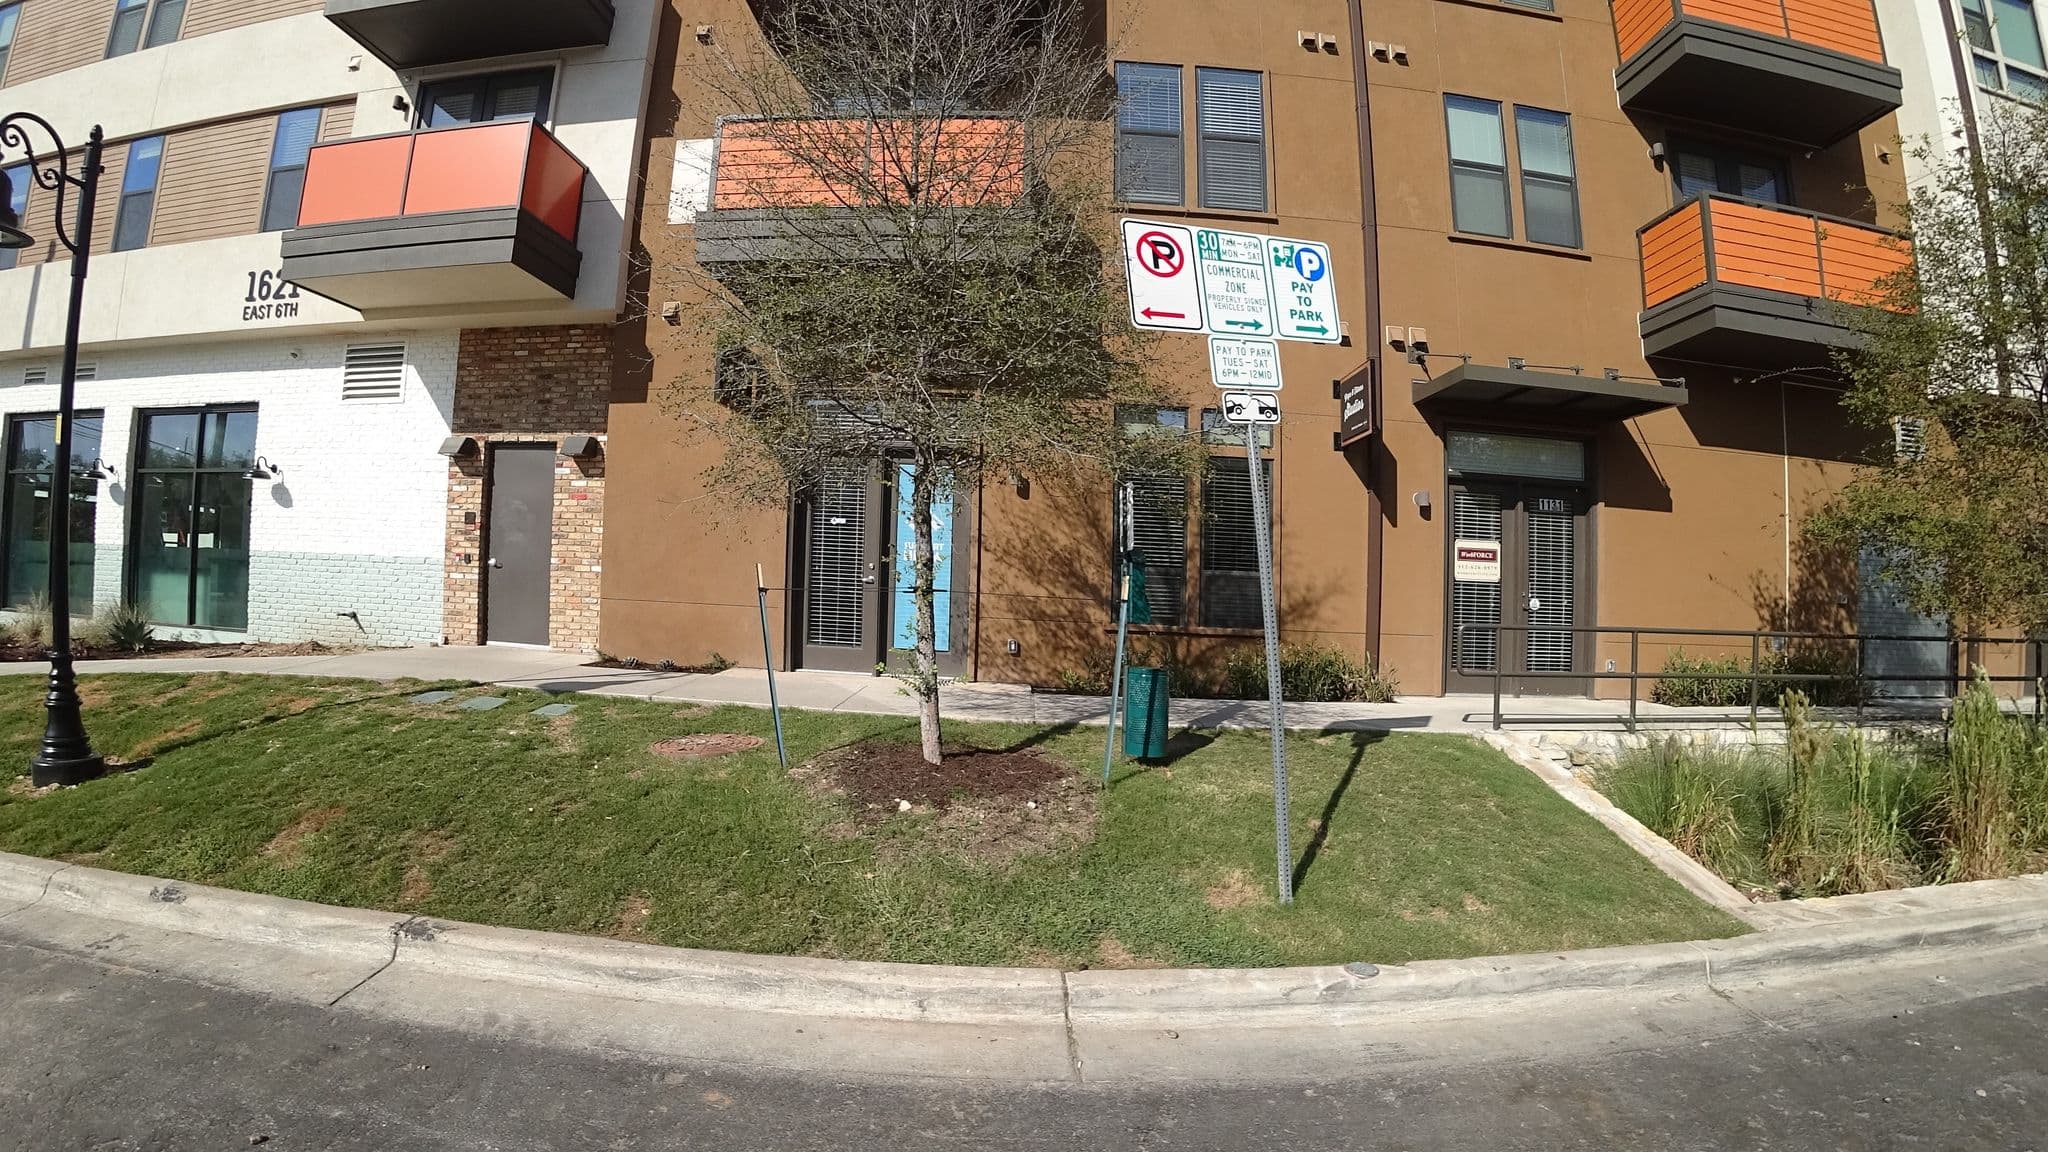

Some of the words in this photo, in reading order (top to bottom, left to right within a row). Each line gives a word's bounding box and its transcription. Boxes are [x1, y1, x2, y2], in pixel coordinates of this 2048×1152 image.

[1199, 231, 1218, 250] 30
[1207, 264, 1261, 281] COMMERCIAL
[1225, 281, 1247, 294] ZONE
[1292, 281, 1314, 294] PAY
[1208, 293, 1241, 304] PROPERLY
[1244, 297, 1267, 306] SIGNED
[1296, 295, 1313, 307] TO
[243, 303, 273, 321] EAST
[275, 302, 299, 319] 6TH
[1213, 301, 1245, 312] VEHICLES
[1246, 304, 1264, 314] ONLY
[1289, 308, 1324, 322] PARK
[1215, 345, 1233, 355] PAY
[1236, 346, 1247, 356] TO
[1250, 347, 1273, 358] PARK
[1540, 499, 1563, 511] 1131
